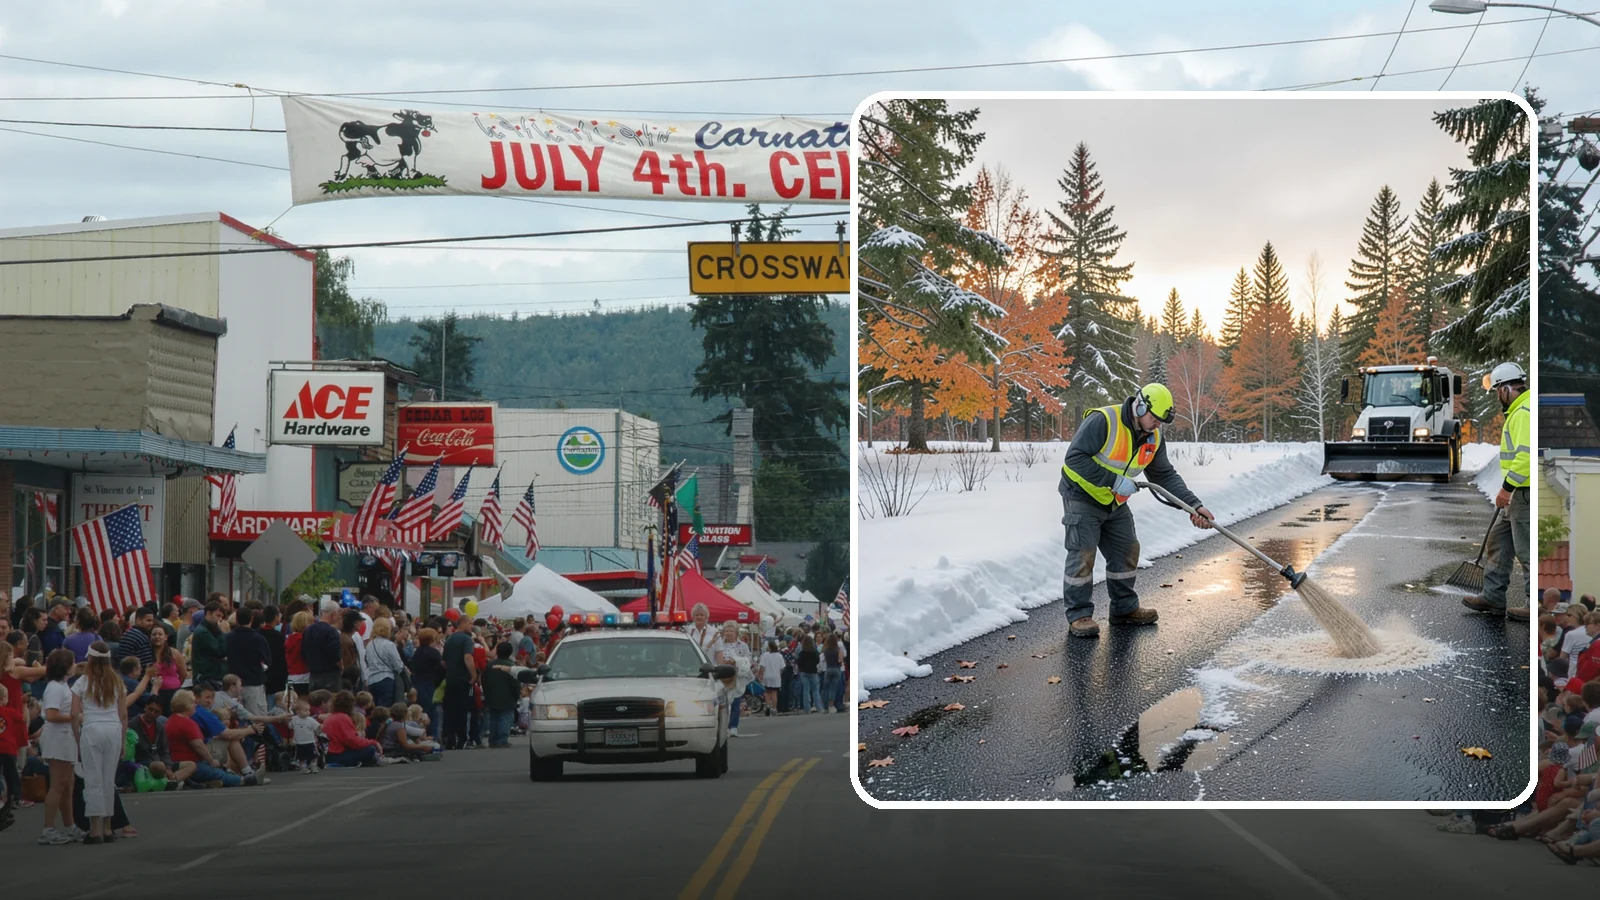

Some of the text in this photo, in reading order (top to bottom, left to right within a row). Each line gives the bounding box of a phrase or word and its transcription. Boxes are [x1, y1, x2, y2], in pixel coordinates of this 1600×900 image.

[695, 122, 850, 149] Carnat
[481, 141, 604, 193] JULY
[632, 150, 746, 197] 4th.
[697, 254, 850, 280] CROSSWA
[282, 379, 374, 420] ACE
[406, 409, 485, 421] CEDAR LOG
[283, 421, 371, 436] Hardware
[416, 428, 477, 447] Coca-Cola
[353, 467, 387, 482] Simpl
[95, 485, 124, 495] Vincent
[126, 486, 136, 495] de
[137, 486, 155, 495] Paul
[688, 526, 741, 535] CRNATION
[699, 535, 730, 543] GLASS
